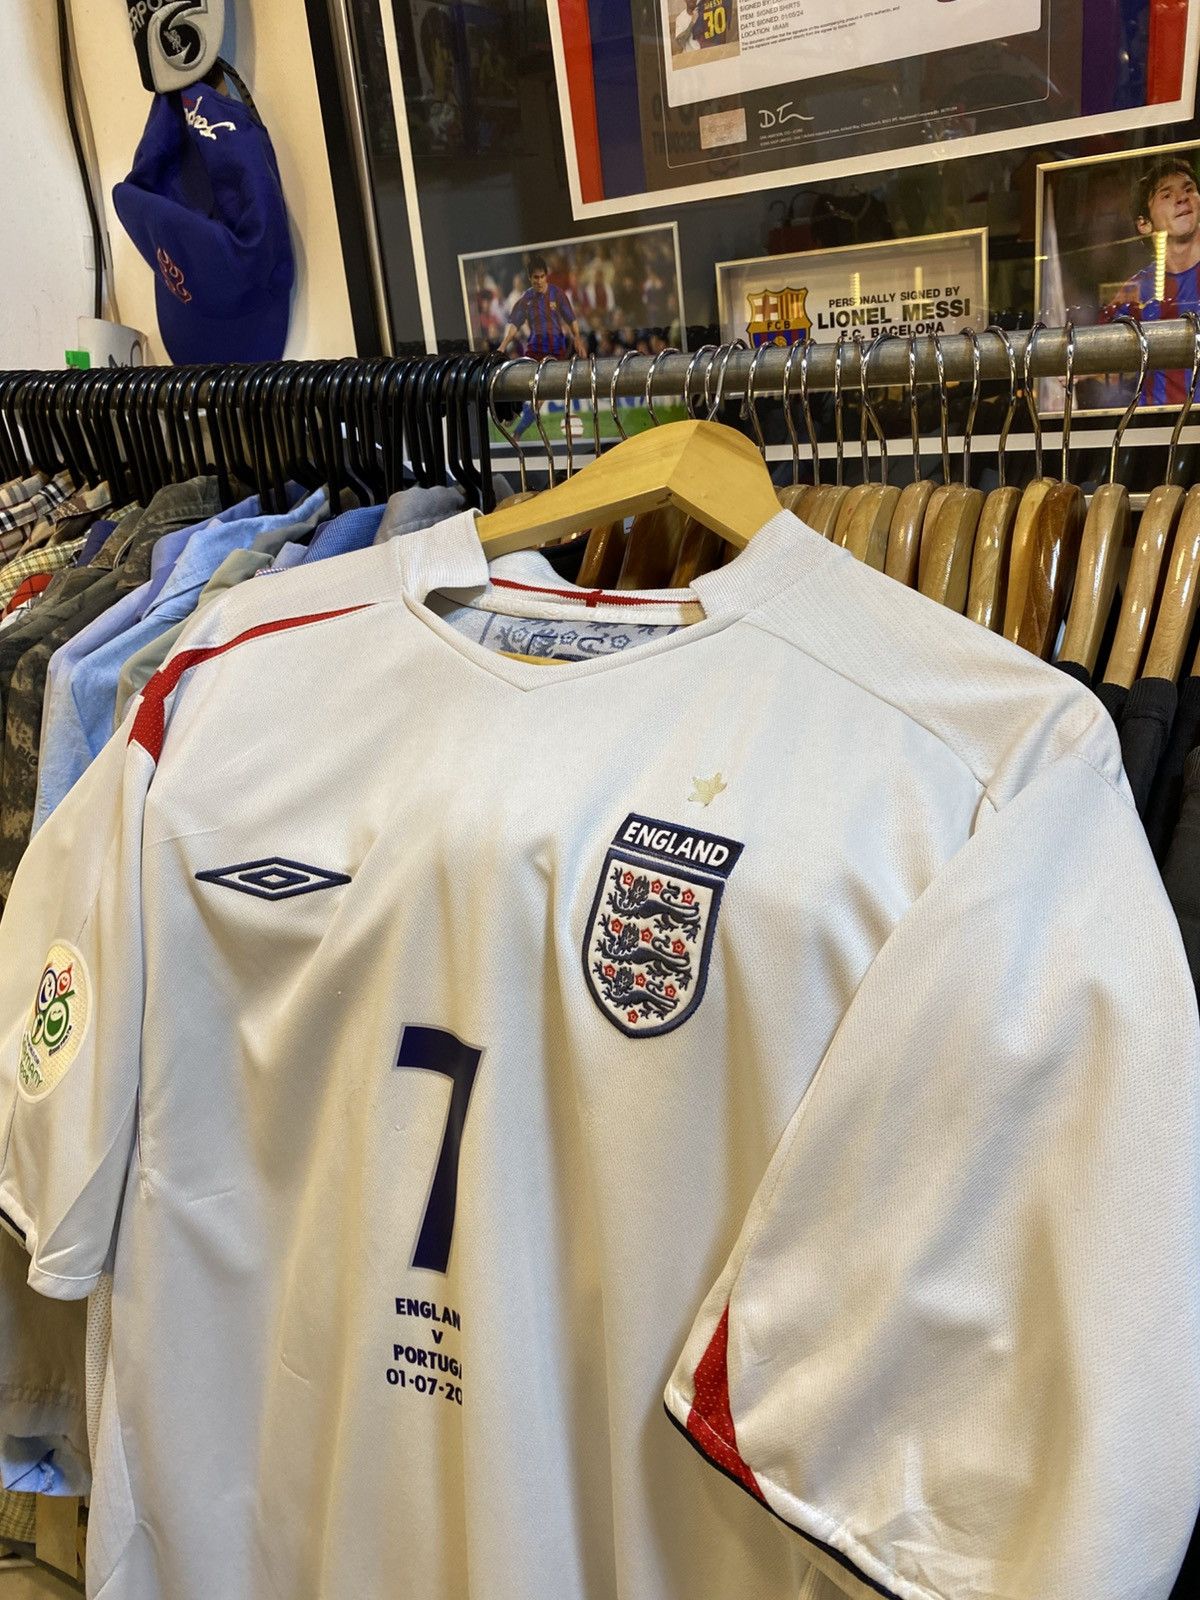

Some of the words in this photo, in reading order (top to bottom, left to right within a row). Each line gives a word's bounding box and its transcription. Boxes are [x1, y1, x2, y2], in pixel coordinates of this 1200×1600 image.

[900, 288, 941, 300] SIGNED
[945, 286, 961, 297] BY
[767, 320, 790, 331] FCB
[817, 306, 892, 330] LIONEL
[902, 298, 971, 322] MESSI
[622, 820, 730, 868] ENGLAND
[394, 1023, 486, 1274] 7
[395, 1297, 461, 1332] ENGLAN
[393, 1344, 462, 1380] PORTUG
